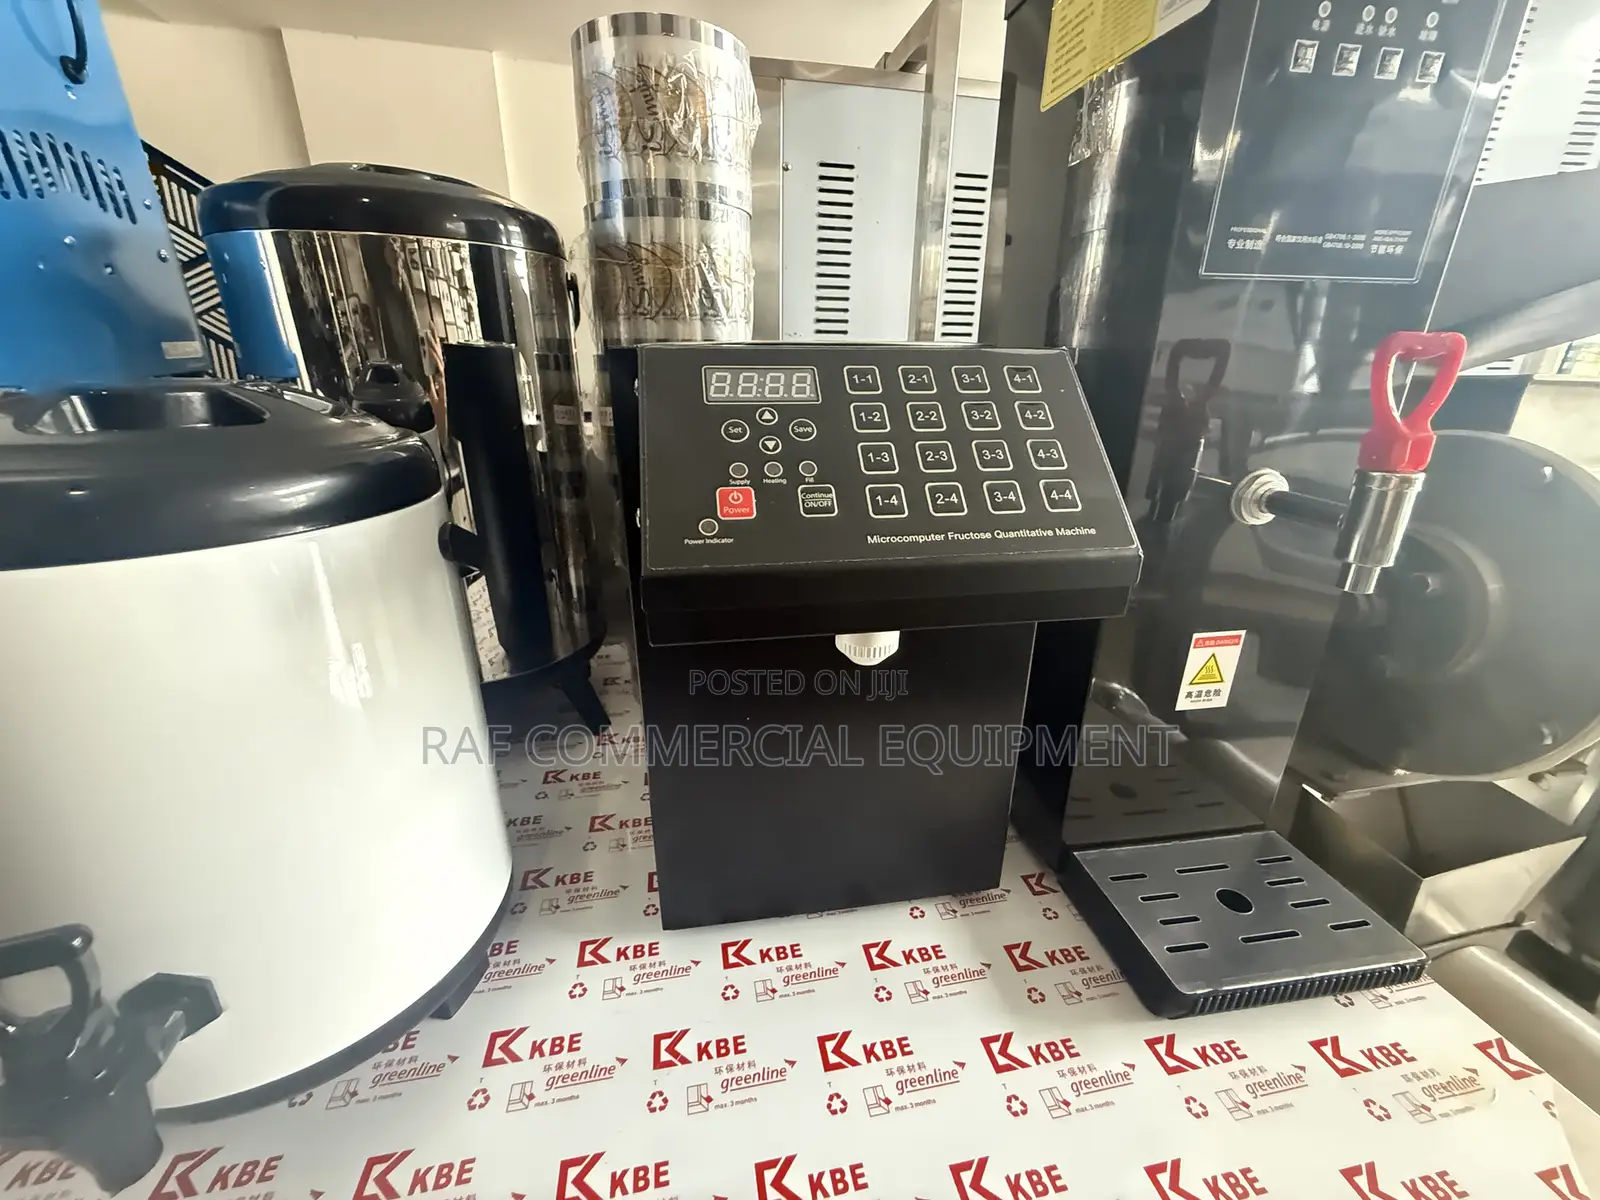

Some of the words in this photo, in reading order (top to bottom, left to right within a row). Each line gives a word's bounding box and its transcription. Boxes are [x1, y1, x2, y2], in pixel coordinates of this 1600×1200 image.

[852, 374, 873, 384] 1-1
[908, 374, 929, 384] 2-1
[961, 373, 982, 384] 3-1
[1014, 373, 1034, 383] 4-1
[859, 411, 882, 422] 1-2
[916, 410, 938, 422] 2-2
[970, 410, 992, 420] 3-2
[1024, 410, 1046, 420] 4-2
[728, 426, 742, 434] Set
[793, 425, 813, 434] Save
[867, 452, 890, 463] 1-3
[925, 450, 948, 462] 2-3
[982, 450, 1004, 460] 3-3
[1037, 449, 1059, 460] 4-3
[729, 478, 751, 486] Supply
[875, 494, 898, 506] 1-4
[935, 493, 958, 504] 2-4
[993, 492, 1016, 502] 3-4
[1050, 490, 1072, 501] 4-4
[723, 506, 750, 514] Power
[804, 500, 832, 508] ON/OFF
[867, 532, 945, 545] Microcomputer
[948, 530, 992, 541] Fructose
[994, 528, 1054, 540] Quantitative
[1055, 526, 1096, 536] Machine
[1185, 688, 1222, 699] 高温危险
[569, 771, 602, 782] KBE
[619, 817, 652, 829] KBE
[554, 871, 594, 887] KBE
[567, 888, 621, 905] greenline
[959, 892, 1007, 908] greenline
[488, 940, 519, 957] BE
[616, 941, 660, 962] KBE
[759, 943, 803, 964] KBE
[902, 944, 946, 965] KBE
[1044, 945, 1090, 966] KBE
[483, 963, 546, 983] greenline
[633, 965, 692, 985] greenline
[782, 966, 839, 987] greenline
[932, 967, 986, 988] greenline
[529, 1032, 582, 1060] KBE
[697, 1035, 747, 1062] KBE
[862, 1036, 914, 1064] KBE
[1027, 1038, 1081, 1065] KBE
[1193, 1039, 1248, 1067] KBE
[1359, 1042, 1417, 1069] KBE
[542, 1057, 587, 1073] 环保材料
[714, 1060, 756, 1076] 环保材料
[885, 1062, 927, 1077] 环保材料
[1056, 1063, 1097, 1079] 环保材料
[368, 1062, 446, 1089] greenline
[544, 1064, 616, 1092] greenline
[721, 1066, 787, 1094] greenline
[896, 1068, 959, 1096] greenline
[1070, 1070, 1132, 1097] greenline
[1245, 1071, 1305, 1099] greenline
[1421, 1075, 1480, 1102] greenline
[735, 1097, 757, 1106] months
[915, 1098, 936, 1108] months
[1094, 1100, 1115, 1109] months
[206, 1154, 284, 1193] KBE
[407, 1157, 476, 1196] KBE
[609, 1160, 670, 1198] KBE
[808, 1162, 869, 1200] KBE
[1005, 1164, 1068, 1200] KBE
[1201, 1167, 1268, 1200] KBE
[1400, 1170, 1470, 1200] KBE
